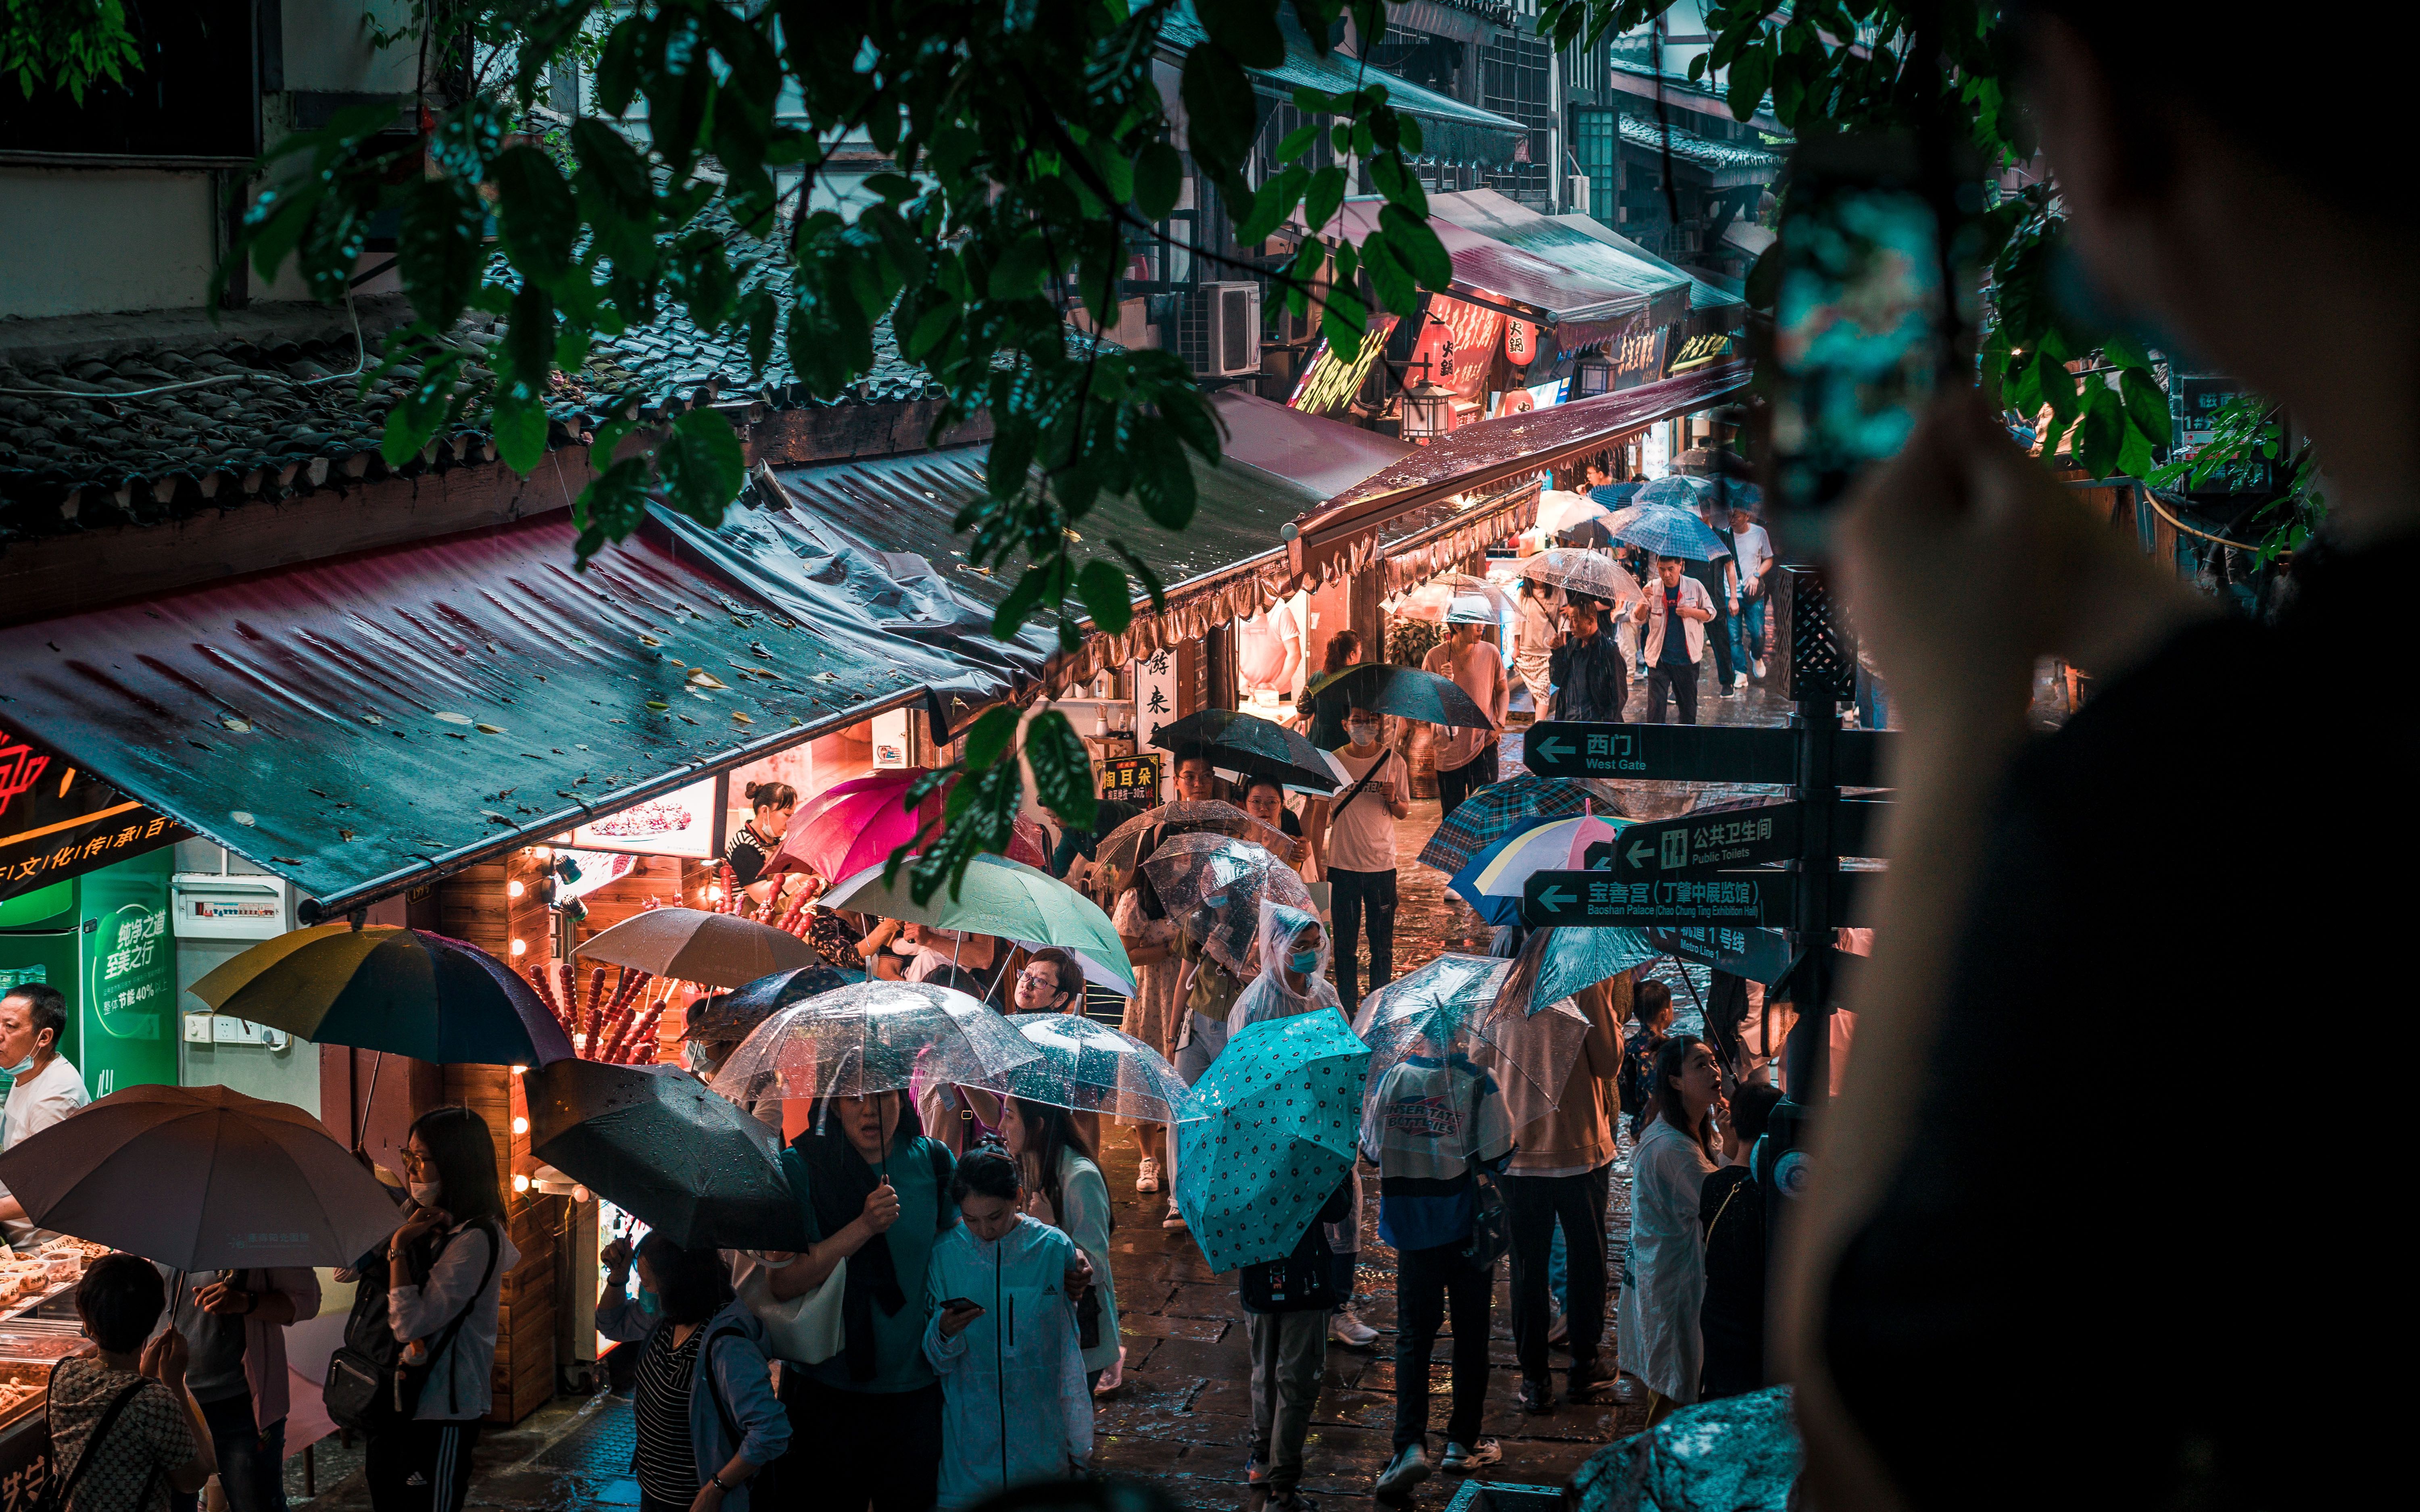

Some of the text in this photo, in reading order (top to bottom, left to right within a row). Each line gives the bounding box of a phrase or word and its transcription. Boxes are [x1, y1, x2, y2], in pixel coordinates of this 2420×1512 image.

[1509, 321, 1524, 352] 火鍋
[1587, 734, 1631, 756] 西门
[1586, 758, 1646, 770] West Gate
[1694, 818, 1772, 849] 公共卫生间
[1692, 847, 1750, 865] Public Toilets
[1588, 904, 1759, 919] Baoshan Palace (Chao Chung Ting Exhibition Hall)
[117, 909, 166, 950] 纯净之道
[104, 939, 154, 980] 至美之行
[1680, 939, 1719, 960] Metro Line 1
